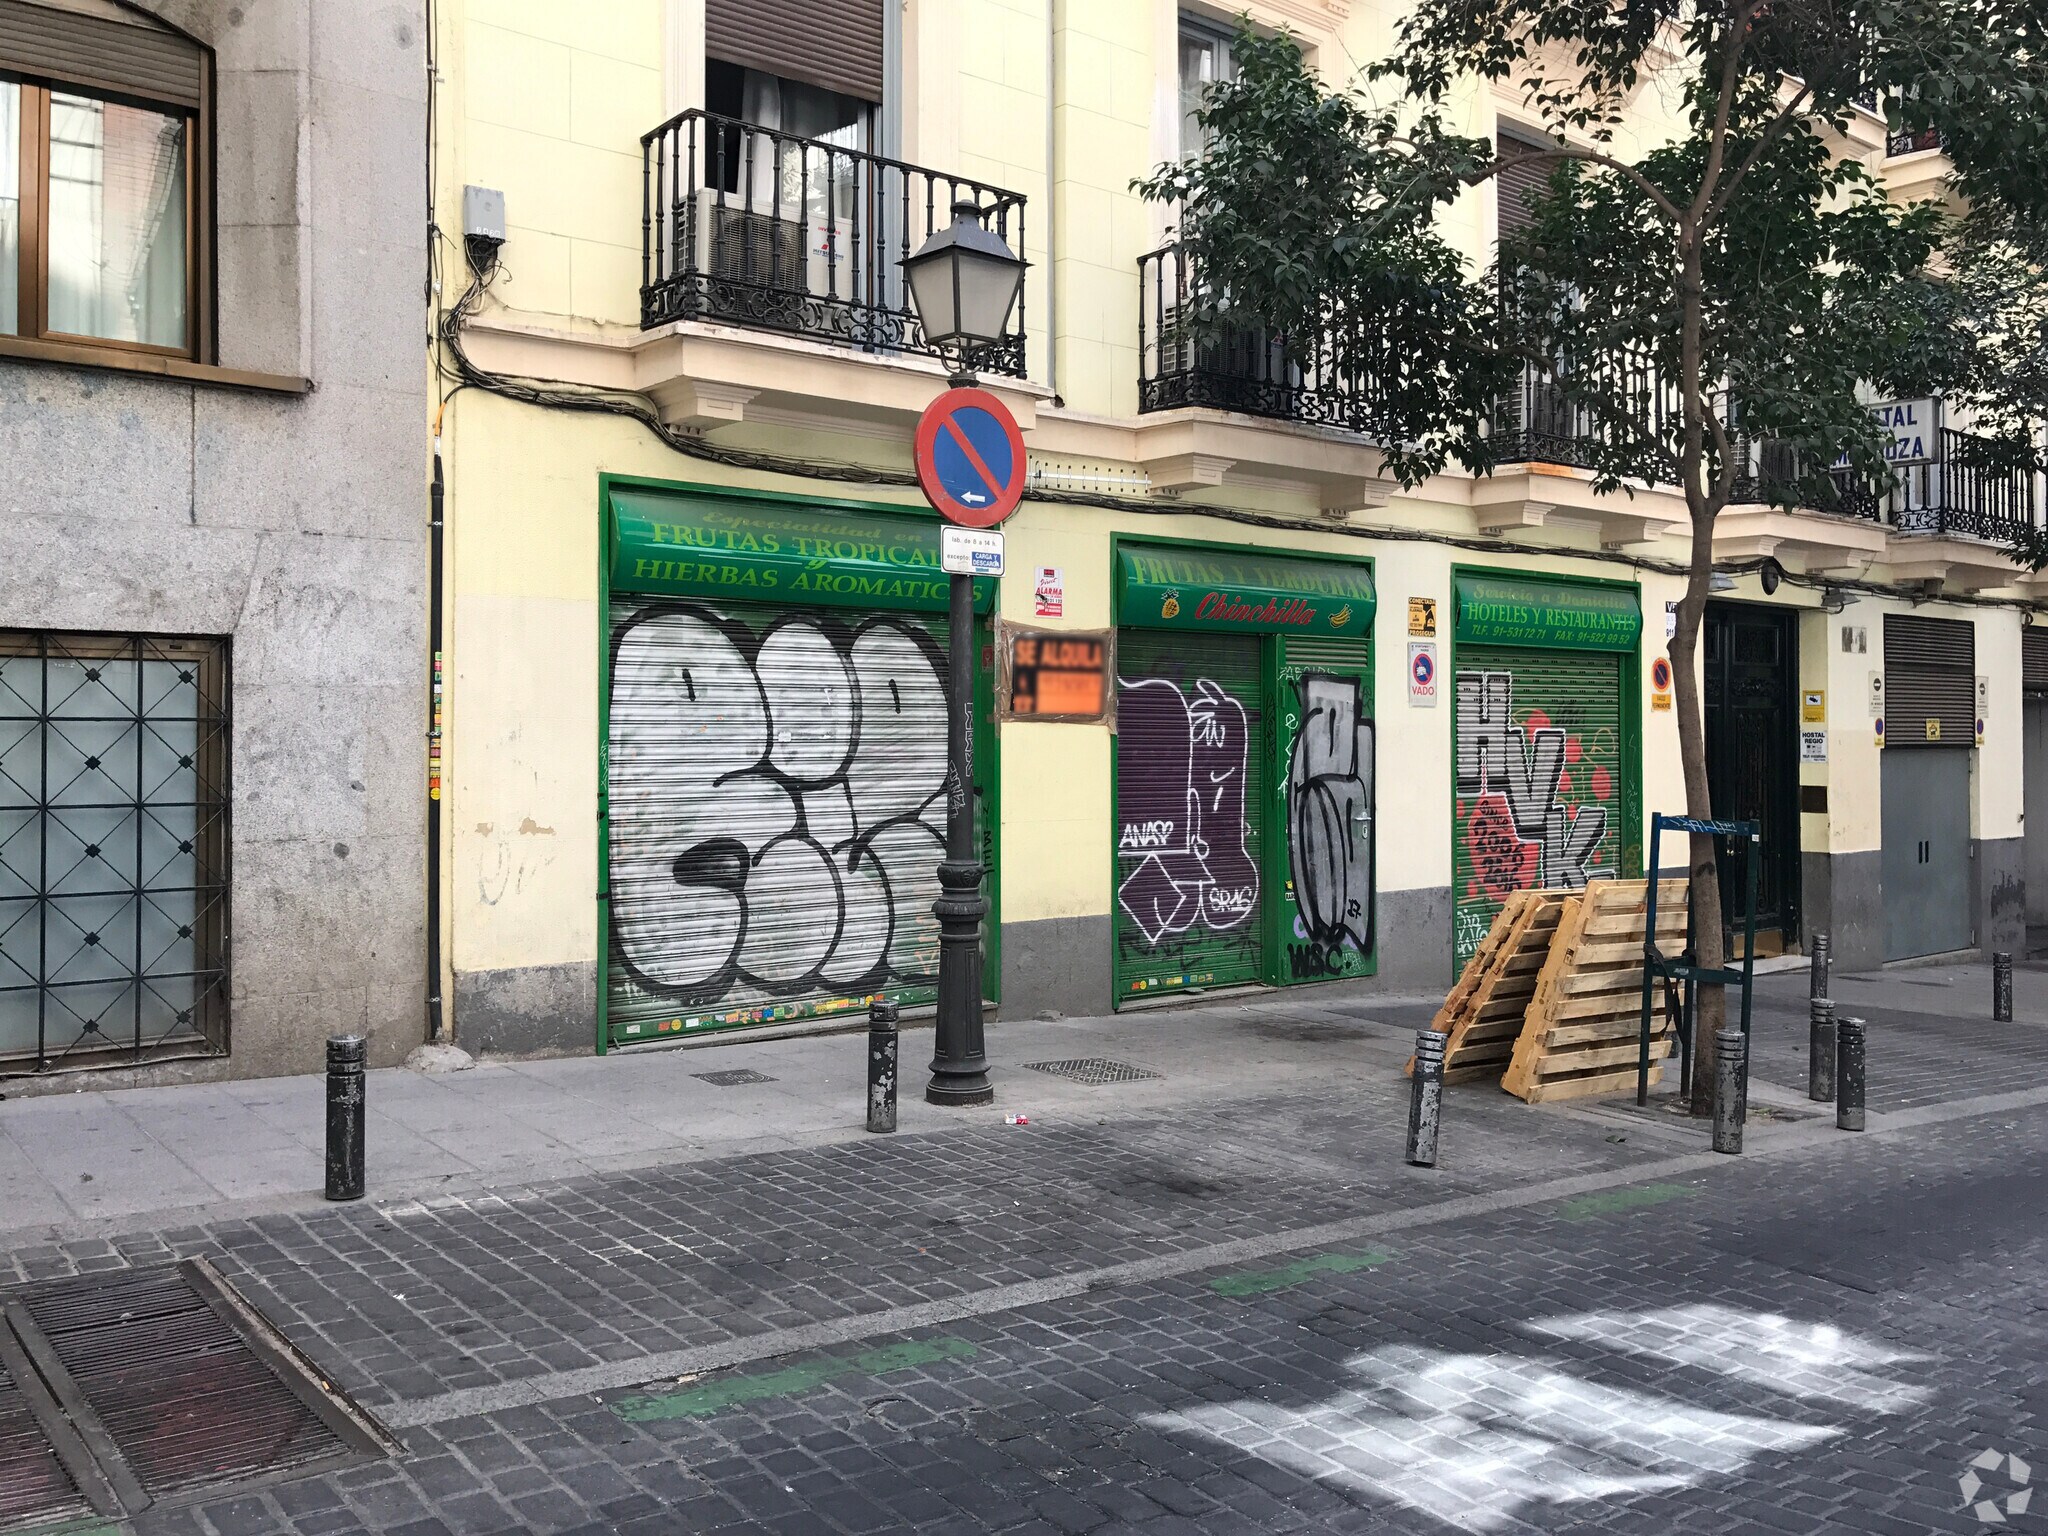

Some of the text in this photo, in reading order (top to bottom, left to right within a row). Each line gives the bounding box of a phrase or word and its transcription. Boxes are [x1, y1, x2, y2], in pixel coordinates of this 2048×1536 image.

[652, 523, 941, 567] FRUTAS TROPICAL
[974, 552, 993, 560] CARGA
[632, 558, 983, 602] HIERBAS AROMATICS
[1036, 587, 1063, 596] ALARMA
[1131, 556, 1371, 601] FRUTAS Y VERDURAS
[1194, 591, 1317, 626] Chinchilla
[1473, 584, 1535, 603] Servicio
[1556, 591, 1628, 610] Domicilio
[1467, 602, 1637, 632] HOTELES Y RESTAURANTES
[1471, 624, 1489, 636] TLF.
[1492, 626, 1523, 637] 91-531
[1554, 630, 1575, 641] FAX:
[1412, 686, 1435, 696] VADO
